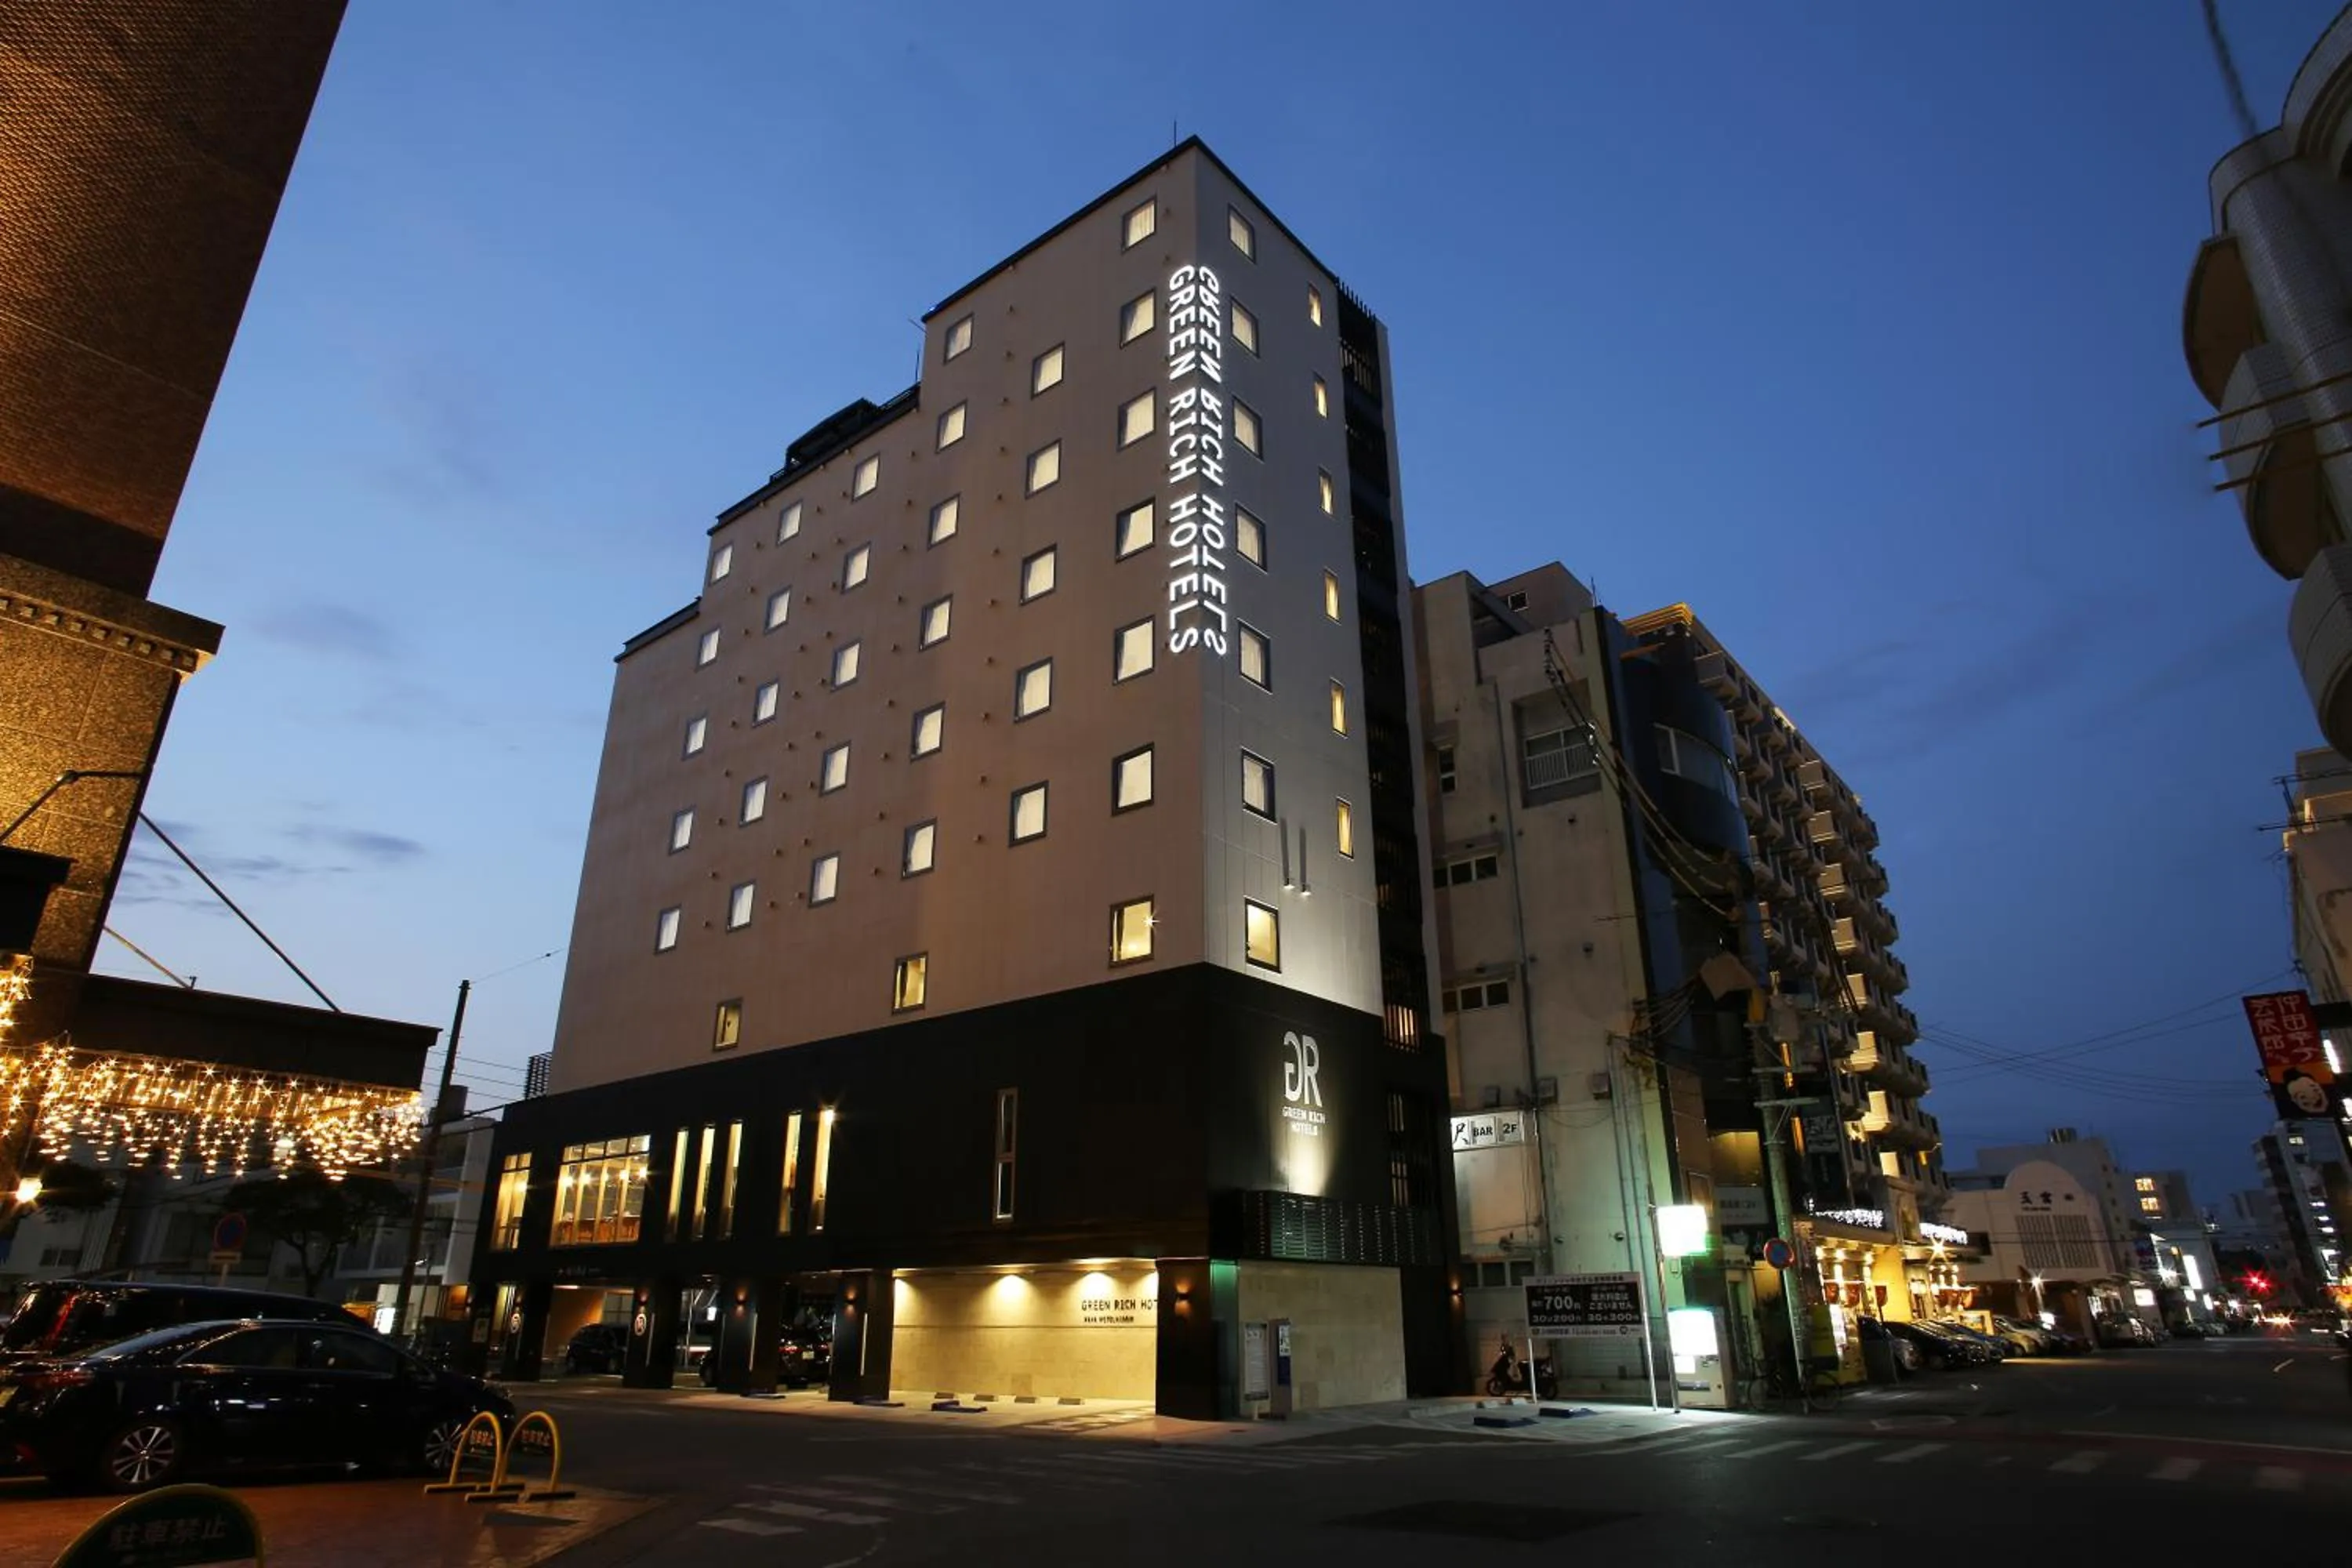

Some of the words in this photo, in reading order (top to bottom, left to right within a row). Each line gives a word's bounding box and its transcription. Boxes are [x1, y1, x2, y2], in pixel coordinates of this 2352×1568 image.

[1168, 263, 1196, 380] GREEN
[1168, 387, 1197, 484] RICH
[1168, 493, 1199, 653] HOTELS
[1282, 1106, 1307, 1120] GREEN
[1308, 1110, 1326, 1123] RICH
[1473, 1126, 1494, 1137] BAR
[1503, 1123, 1518, 1134] 2F
[1081, 1299, 1110, 1311] GREEN
[1114, 1299, 1136, 1310] RICH
[110, 1515, 227, 1551] 駐車禁止
